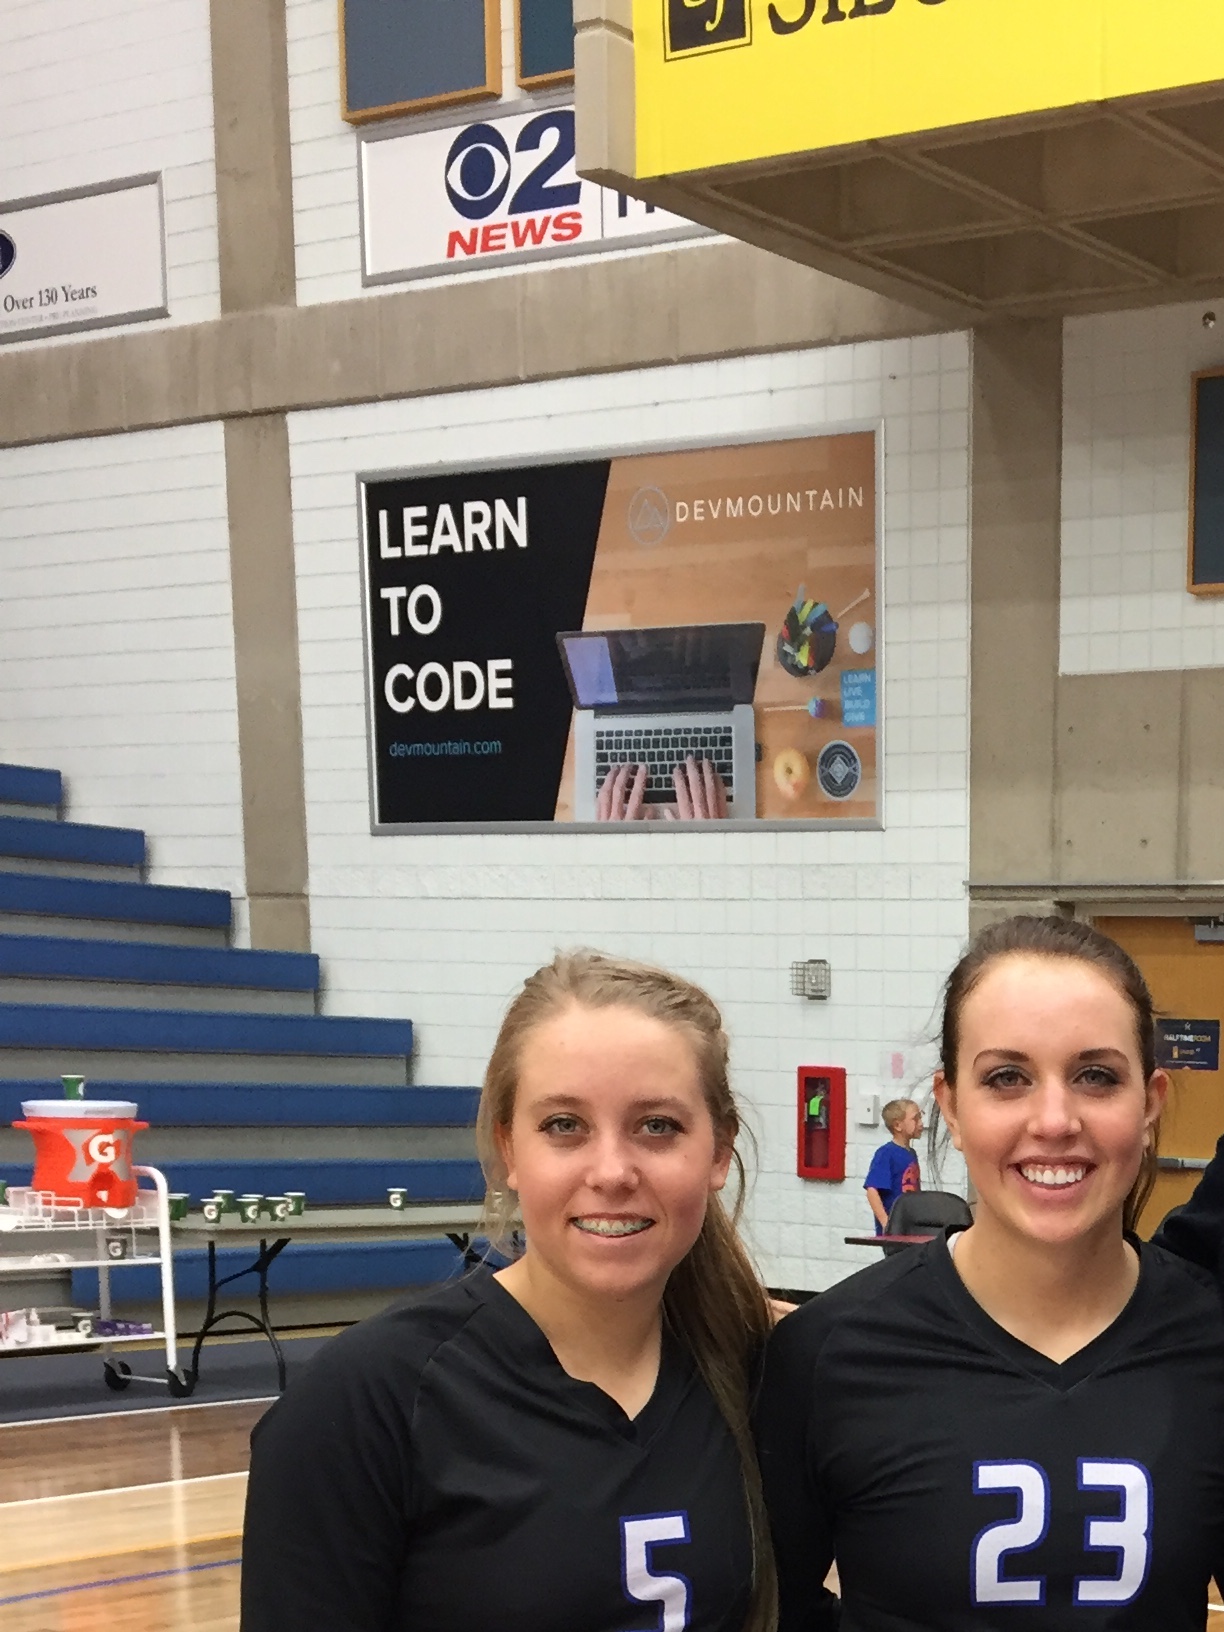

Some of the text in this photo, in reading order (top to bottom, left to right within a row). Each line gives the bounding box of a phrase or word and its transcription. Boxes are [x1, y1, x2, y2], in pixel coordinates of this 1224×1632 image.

[508, 109, 582, 215] 2
[446, 211, 583, 259] NEWS
[3, 284, 98, 313] Over 130 Years
[378, 496, 528, 559] LEARN
[676, 486, 864, 523] DEVMOUNTAIN
[380, 584, 442, 636] TO
[384, 659, 514, 713] CODE
[389, 738, 502, 758] devmountain.com
[88, 1133, 116, 1163] G
[203, 1204, 219, 1220] G
[968, 1457, 1154, 1606] 23
